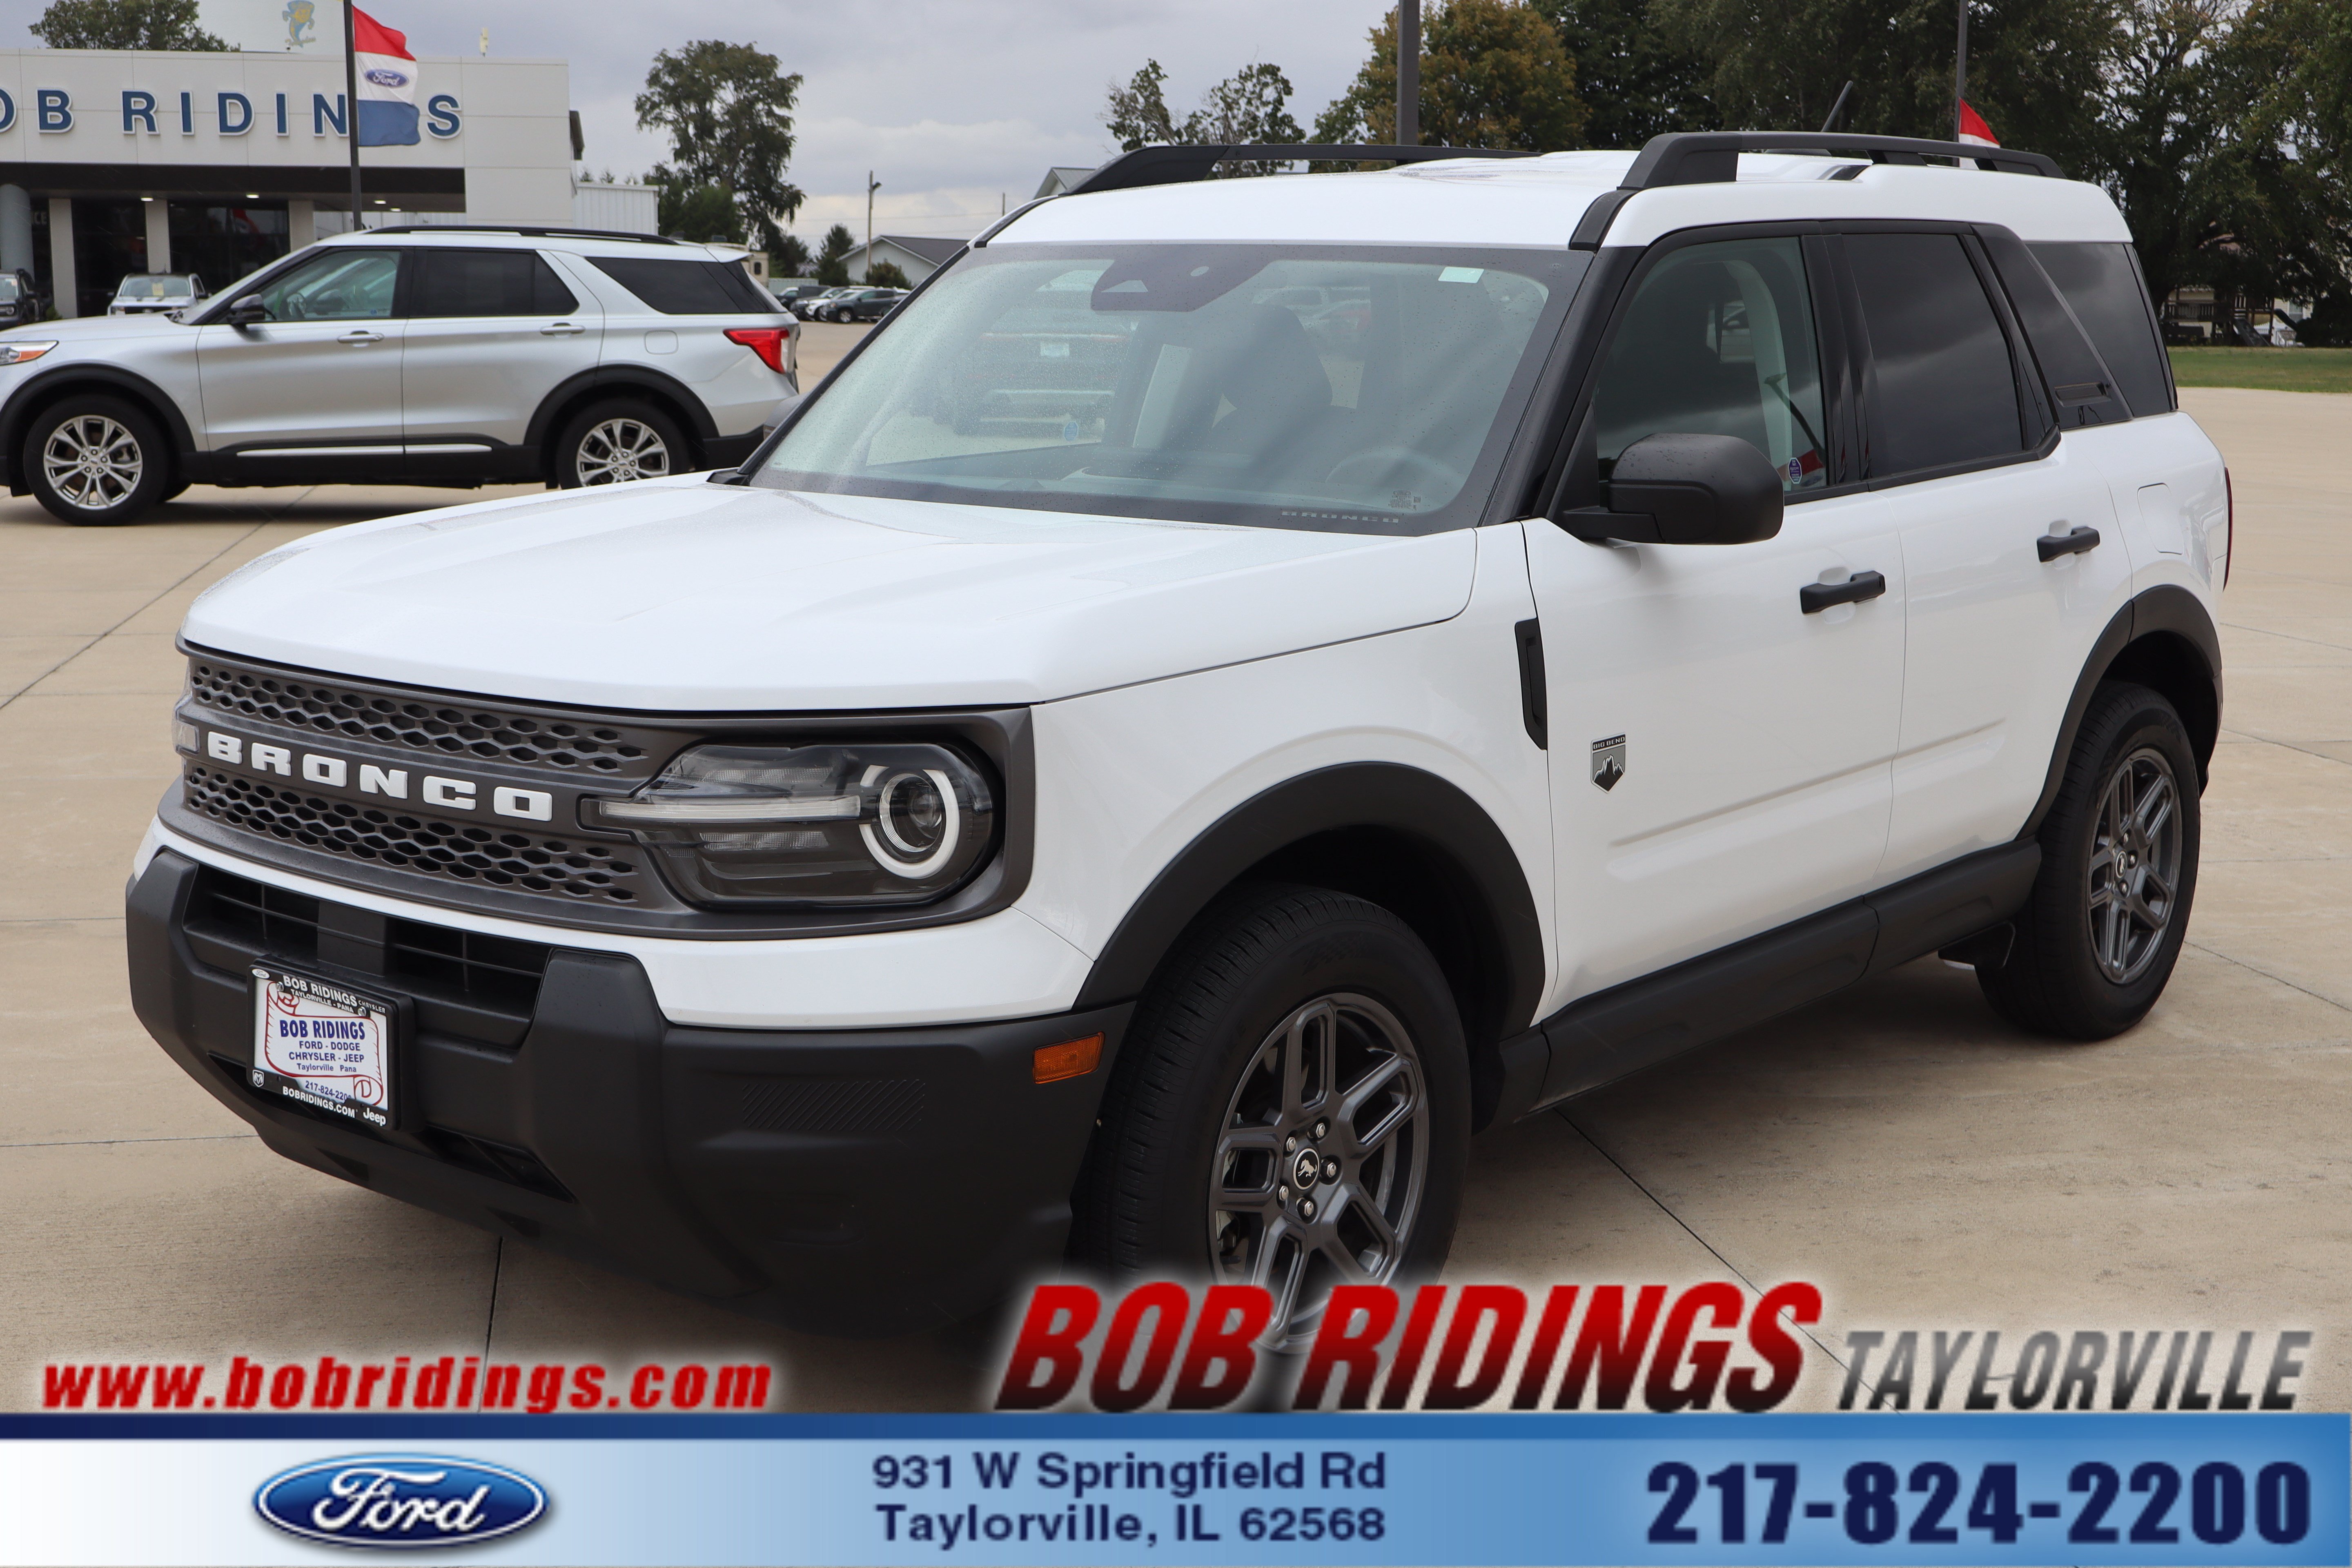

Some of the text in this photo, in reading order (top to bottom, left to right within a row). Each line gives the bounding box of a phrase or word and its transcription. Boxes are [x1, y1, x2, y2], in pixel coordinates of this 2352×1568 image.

[372, 71, 400, 86] Ford
[122, 89, 462, 139] RIDINS
[1606, 736, 1625, 746] BEND
[207, 731, 553, 821] BRONCO
[283, 975, 358, 1007] BOB RIDINGS
[290, 989, 332, 1006] TAYLORVILLE
[336, 1002, 354, 1013] PANA
[358, 1000, 386, 1014] CHRYSLER
[280, 1020, 365, 1040] BOB RIDINGS
[299, 1040, 323, 1050] FORD
[330, 1042, 361, 1051] DODGE
[289, 1051, 336, 1062] CHRYSLER
[343, 1054, 365, 1063] JEEP
[296, 1063, 334, 1072] Taylorville
[282, 1086, 356, 1118] BOBRIDINGS.COM
[363, 1107, 387, 1127] Jeep
